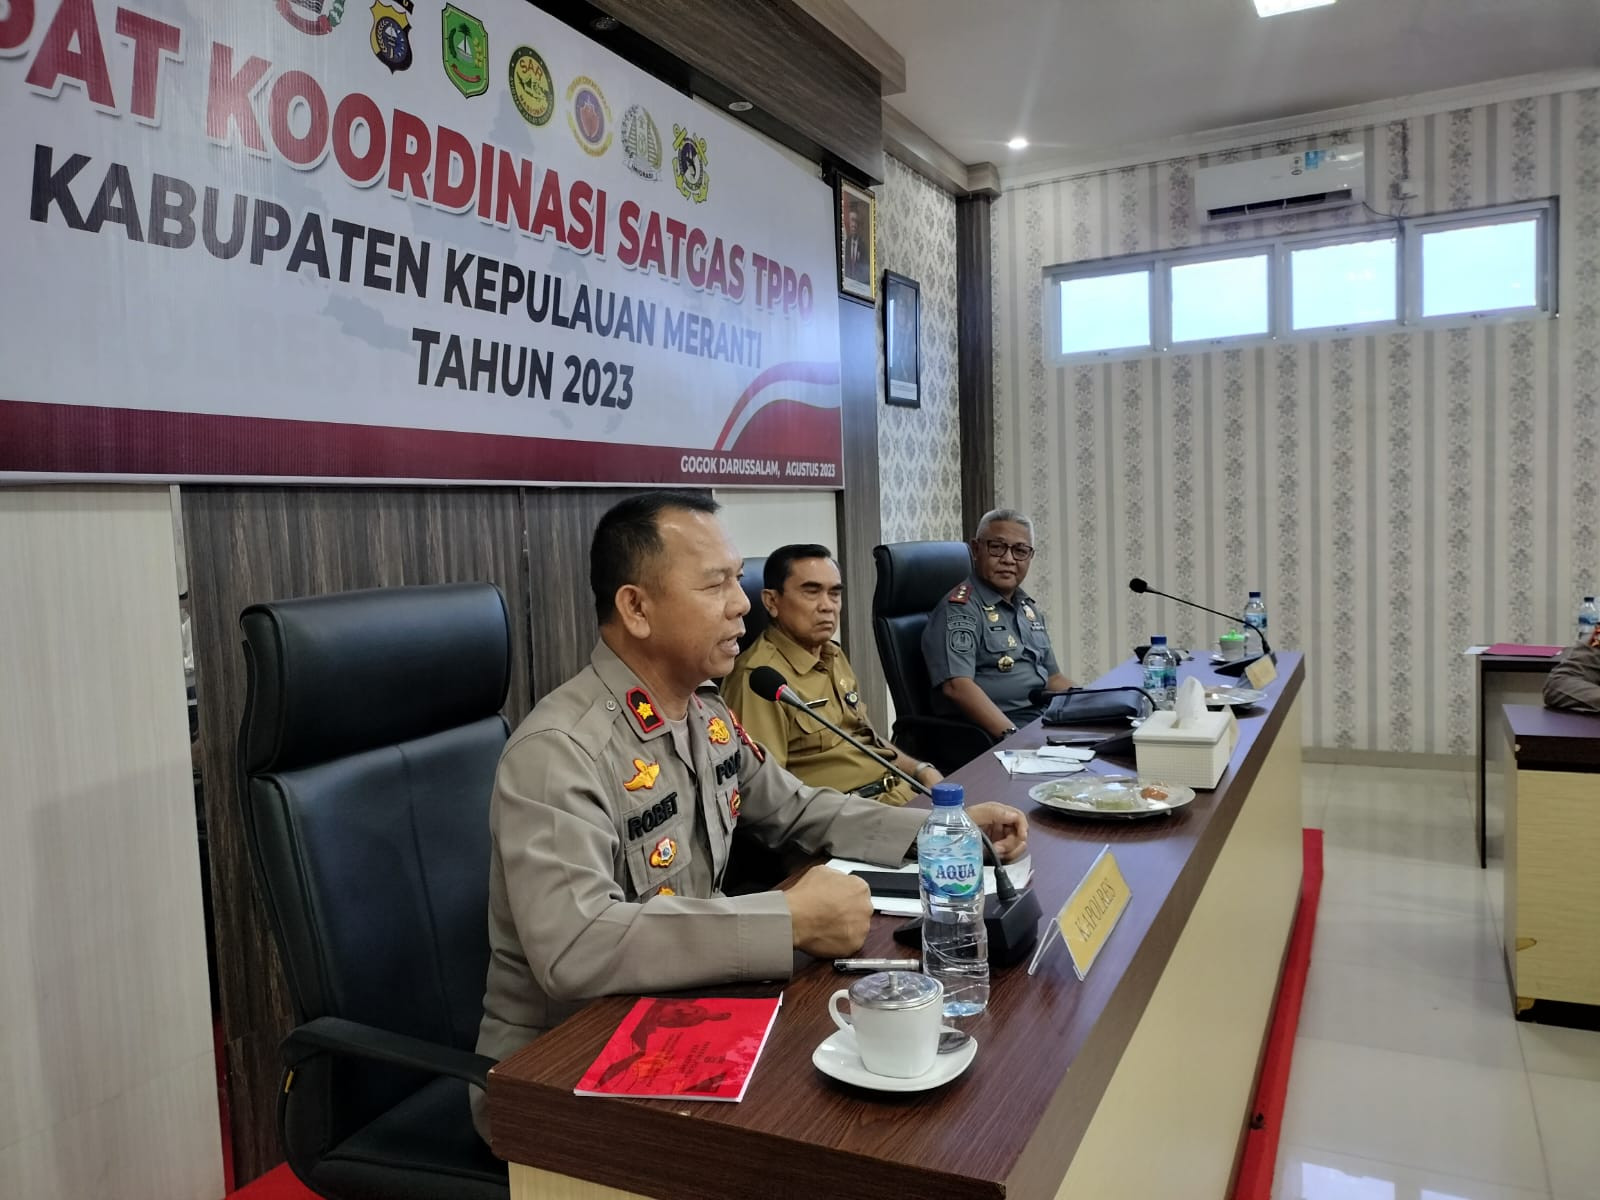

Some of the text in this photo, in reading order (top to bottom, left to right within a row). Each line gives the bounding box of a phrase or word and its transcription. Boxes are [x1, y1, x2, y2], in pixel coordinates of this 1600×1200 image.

[206, 41, 607, 256] KOORDINASI
[617, 200, 745, 301] SATGAS
[752, 251, 813, 316] TPPO
[29, 143, 762, 369] KABUPATEN KEPULAUAN MERANTI
[412, 327, 634, 410] TAHUN 2023
[680, 455, 836, 478] GOGOK DARUSSALAM, AGUSTUS 2023
[628, 792, 678, 841] ROBET
[936, 864, 976, 881] AQUA
[1074, 877, 1117, 943] KAPOLRES
